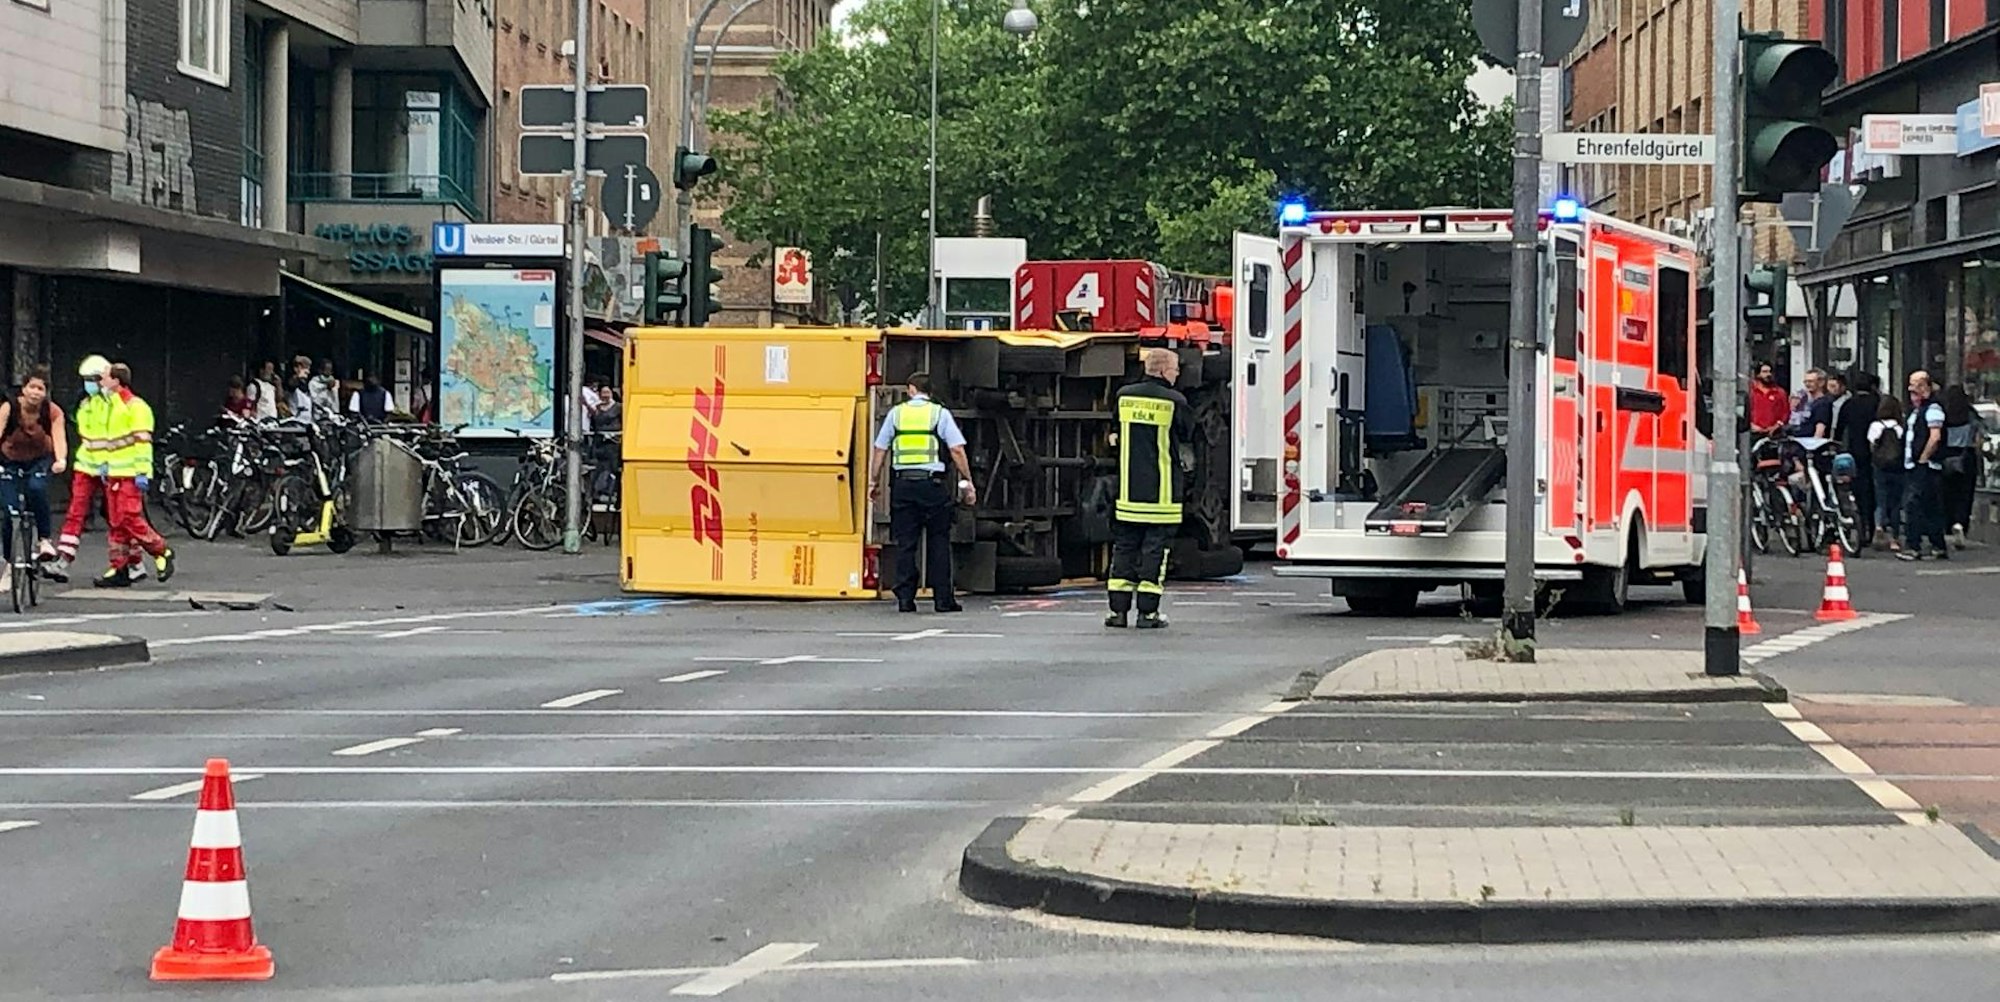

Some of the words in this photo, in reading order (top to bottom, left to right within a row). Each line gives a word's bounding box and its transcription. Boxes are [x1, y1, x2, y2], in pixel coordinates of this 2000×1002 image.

[1576, 138, 1703, 160] Ehrenfeldgürtel
[438, 226, 460, 252] U
[471, 234, 505, 244] Venloer
[508, 233, 524, 244] Str.
[530, 233, 559, 244] Gürtel
[1065, 272, 1105, 317] 4
[687, 377, 725, 550] DHL
